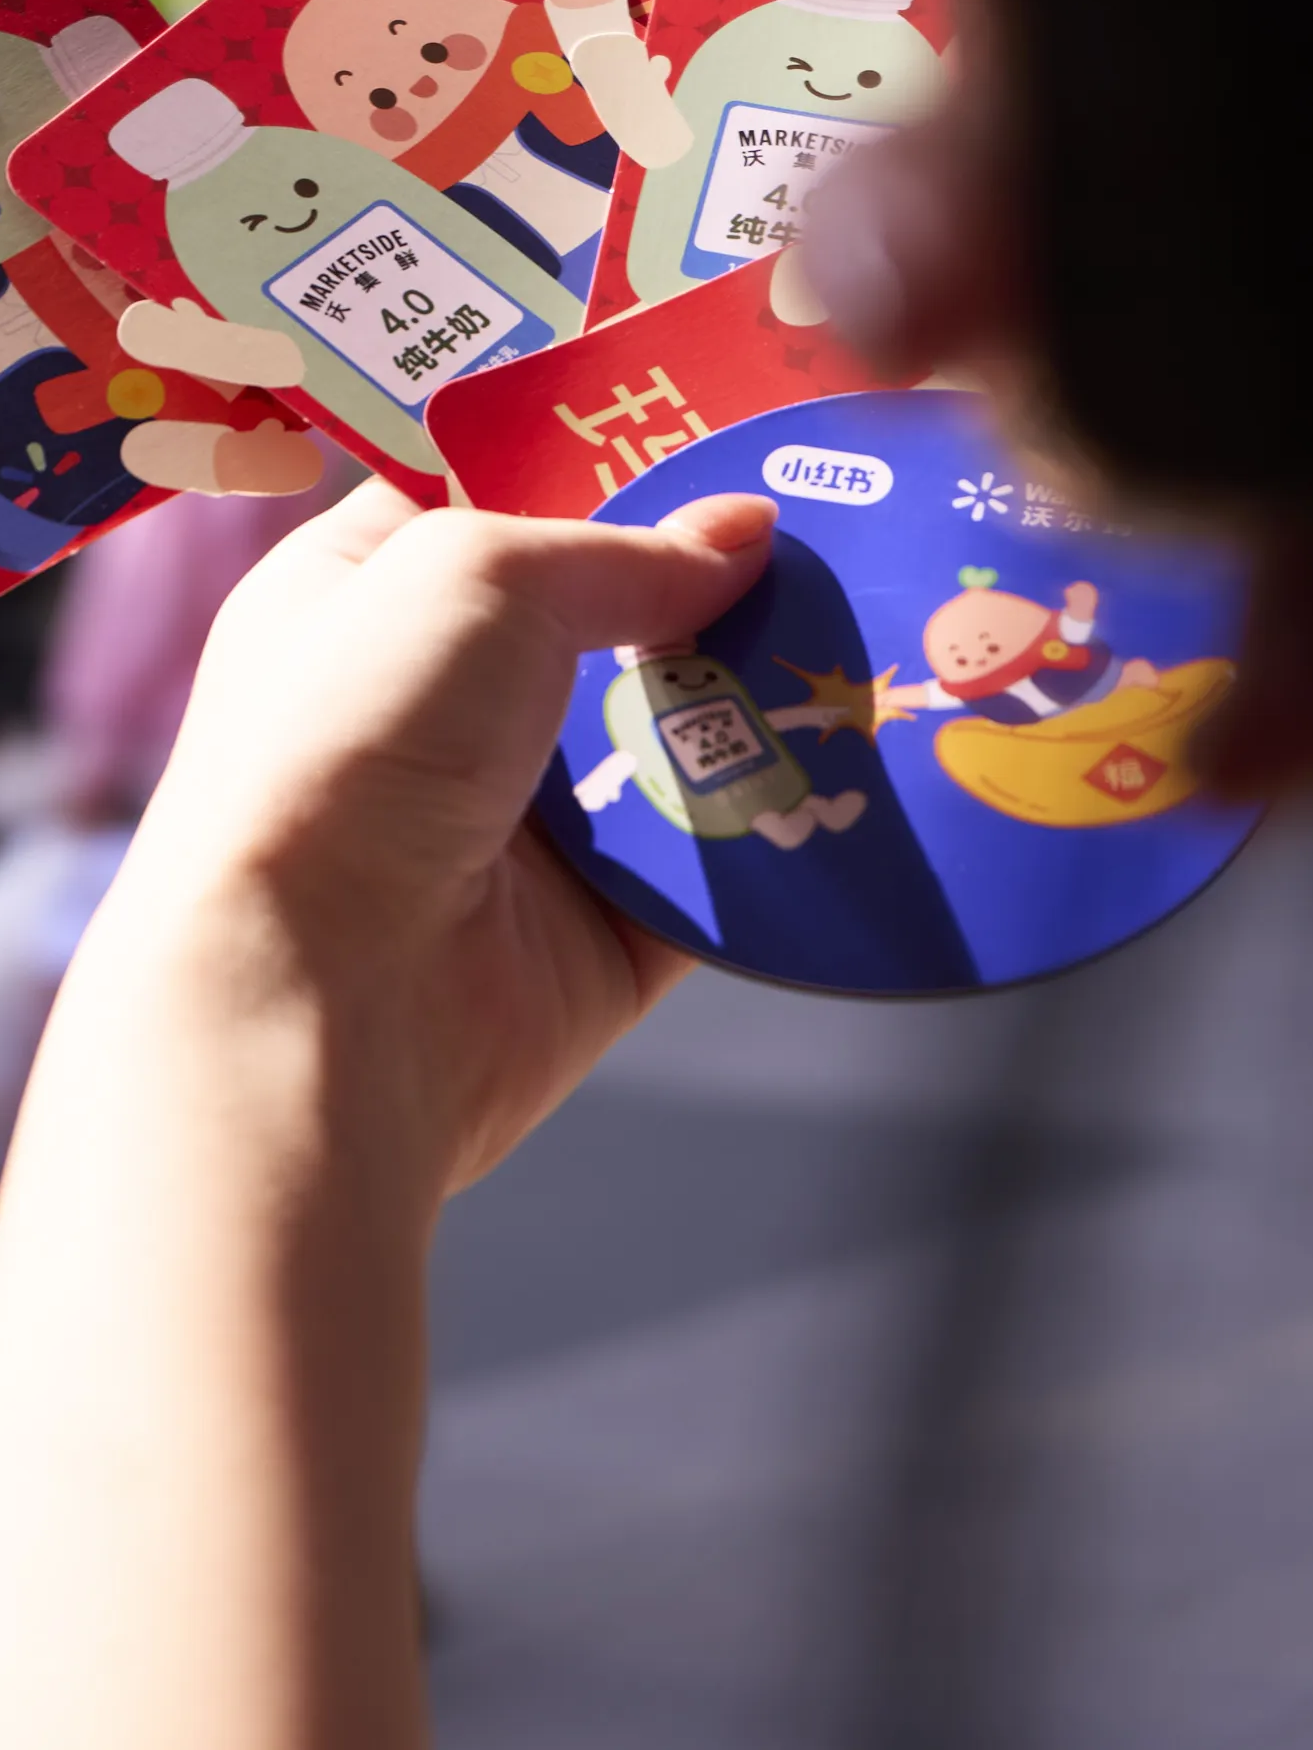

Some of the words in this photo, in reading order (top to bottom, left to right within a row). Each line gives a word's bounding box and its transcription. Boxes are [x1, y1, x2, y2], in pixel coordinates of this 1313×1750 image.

[742, 150, 818, 172] 沃集
[762, 184, 801, 213] 4.
[726, 213, 804, 246] 纯牛
[299, 229, 408, 312] MARKETSIDE
[324, 249, 419, 323] 沃集鲜
[381, 289, 434, 334] 4.0
[393, 304, 491, 381] 纯牛奶
[781, 457, 876, 494] 小红书
